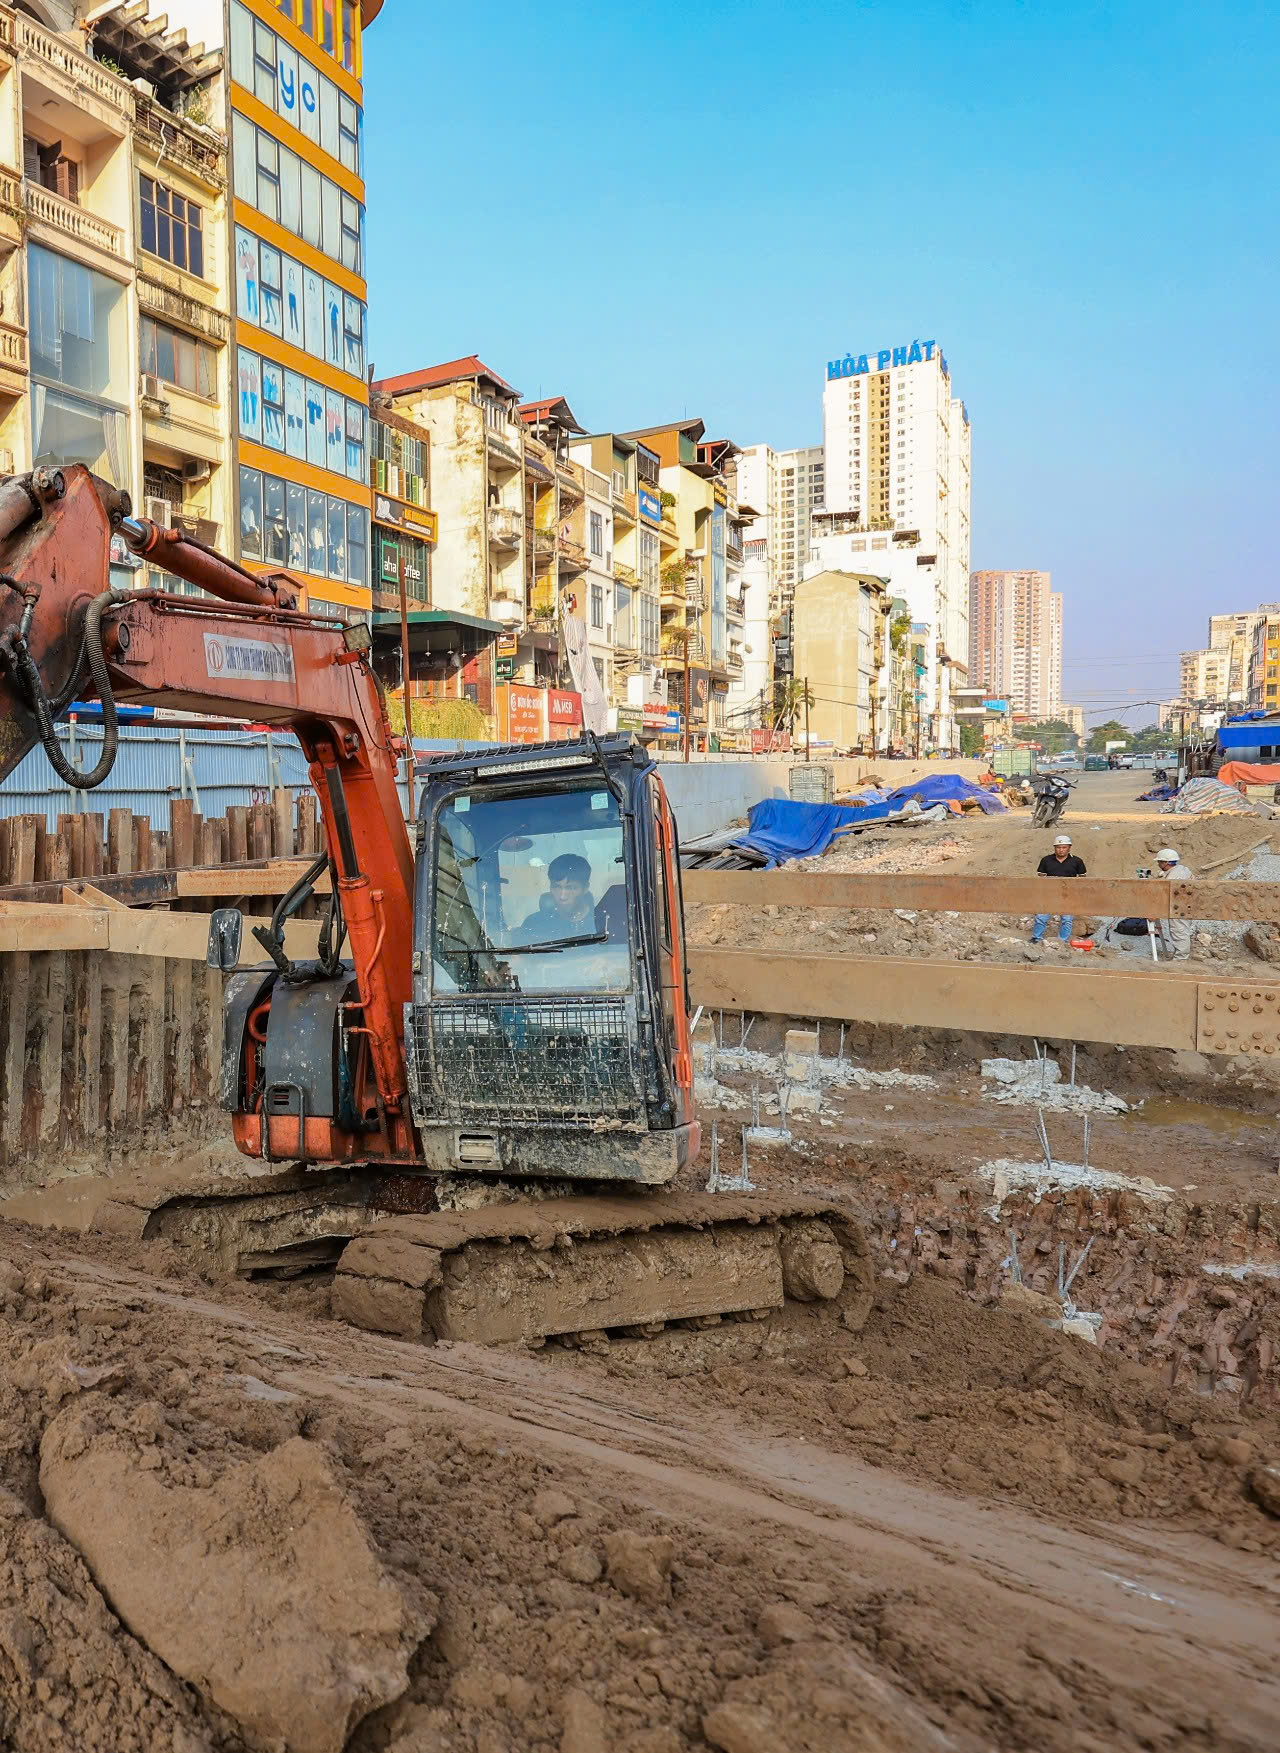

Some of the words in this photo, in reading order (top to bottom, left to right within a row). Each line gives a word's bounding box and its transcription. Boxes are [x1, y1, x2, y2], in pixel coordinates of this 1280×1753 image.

[827, 352, 870, 381] HÒA
[877, 338, 936, 372] PHÁT
[384, 555, 397, 574] aha
[404, 564, 421, 580] offee
[497, 663, 511, 673] aha
[561, 700, 573, 714] MSB
